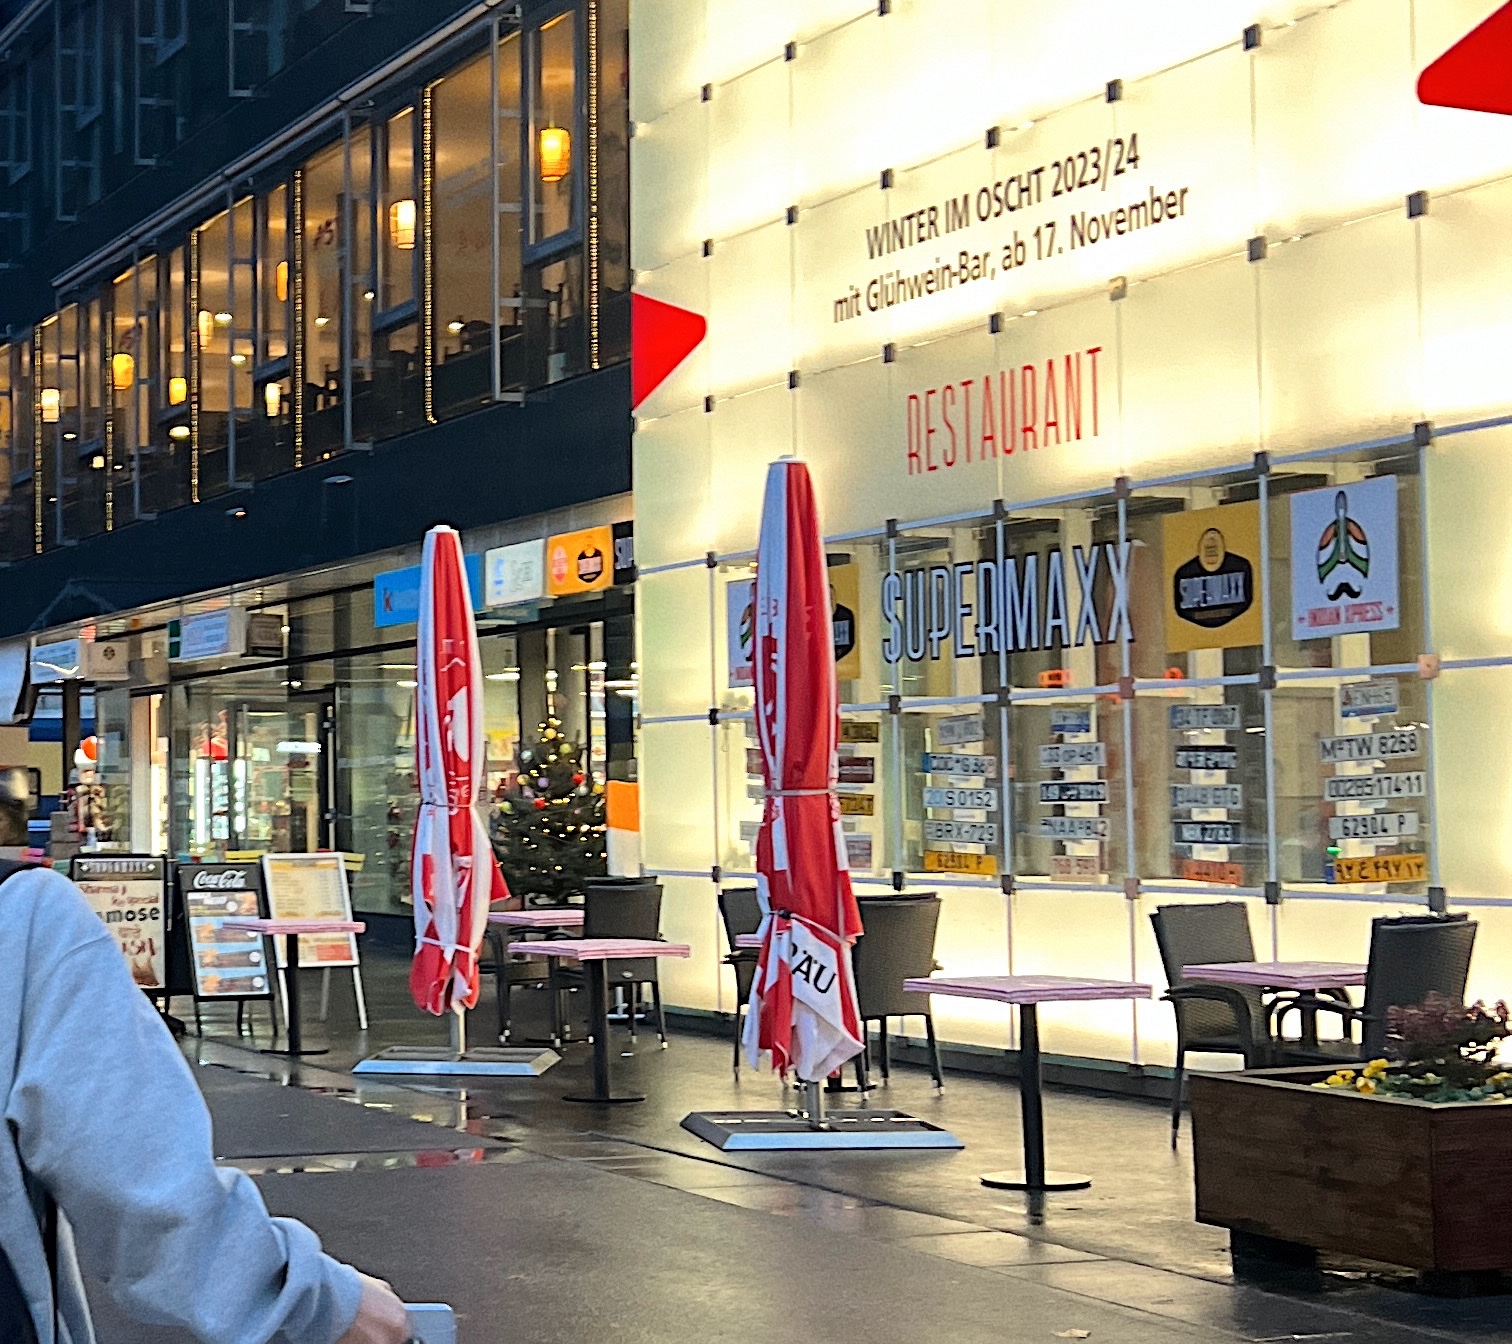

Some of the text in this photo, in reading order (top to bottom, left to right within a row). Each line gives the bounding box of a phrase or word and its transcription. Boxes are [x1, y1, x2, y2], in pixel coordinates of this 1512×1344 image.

[834, 186, 1188, 323] mit Glühwein-Bar, ab 17. November
[866, 133, 1139, 259] WINTER IM OSCHT 2023/24
[907, 346, 1102, 475] RESTAURANT
[881, 539, 1135, 664] SUPERMAXX
